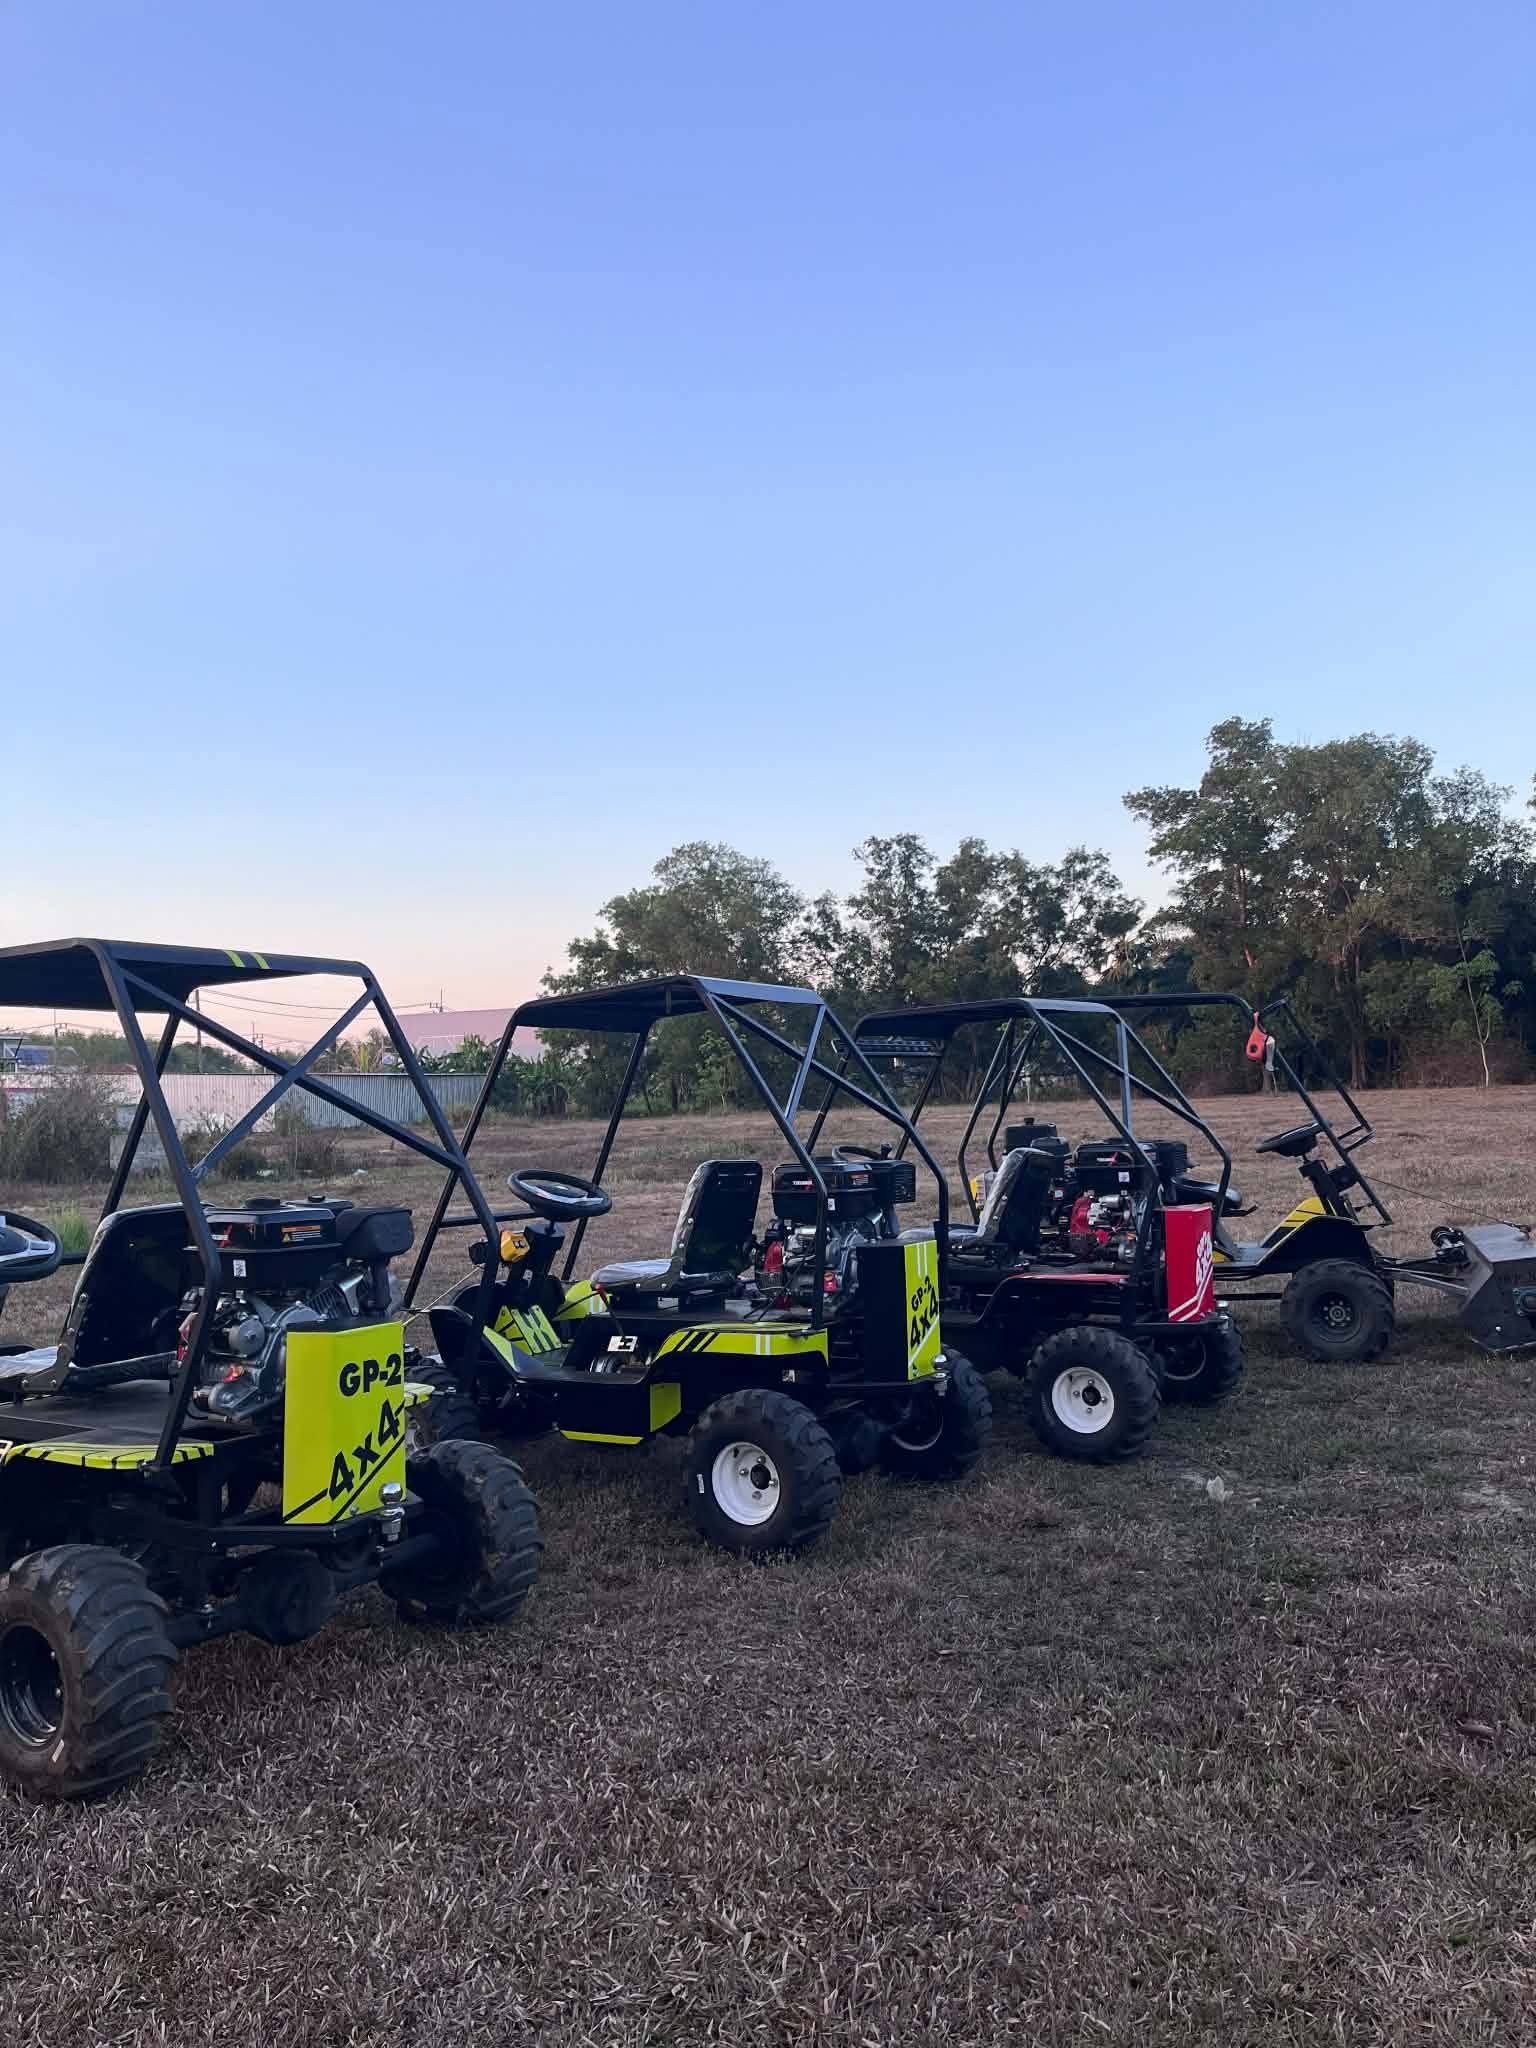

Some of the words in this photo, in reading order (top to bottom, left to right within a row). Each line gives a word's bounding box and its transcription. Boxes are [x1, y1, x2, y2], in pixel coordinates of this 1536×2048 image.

[911, 1275, 932, 1311] GP-2
[339, 1353, 402, 1397] GP-2
[328, 1399, 401, 1501] 4x4
